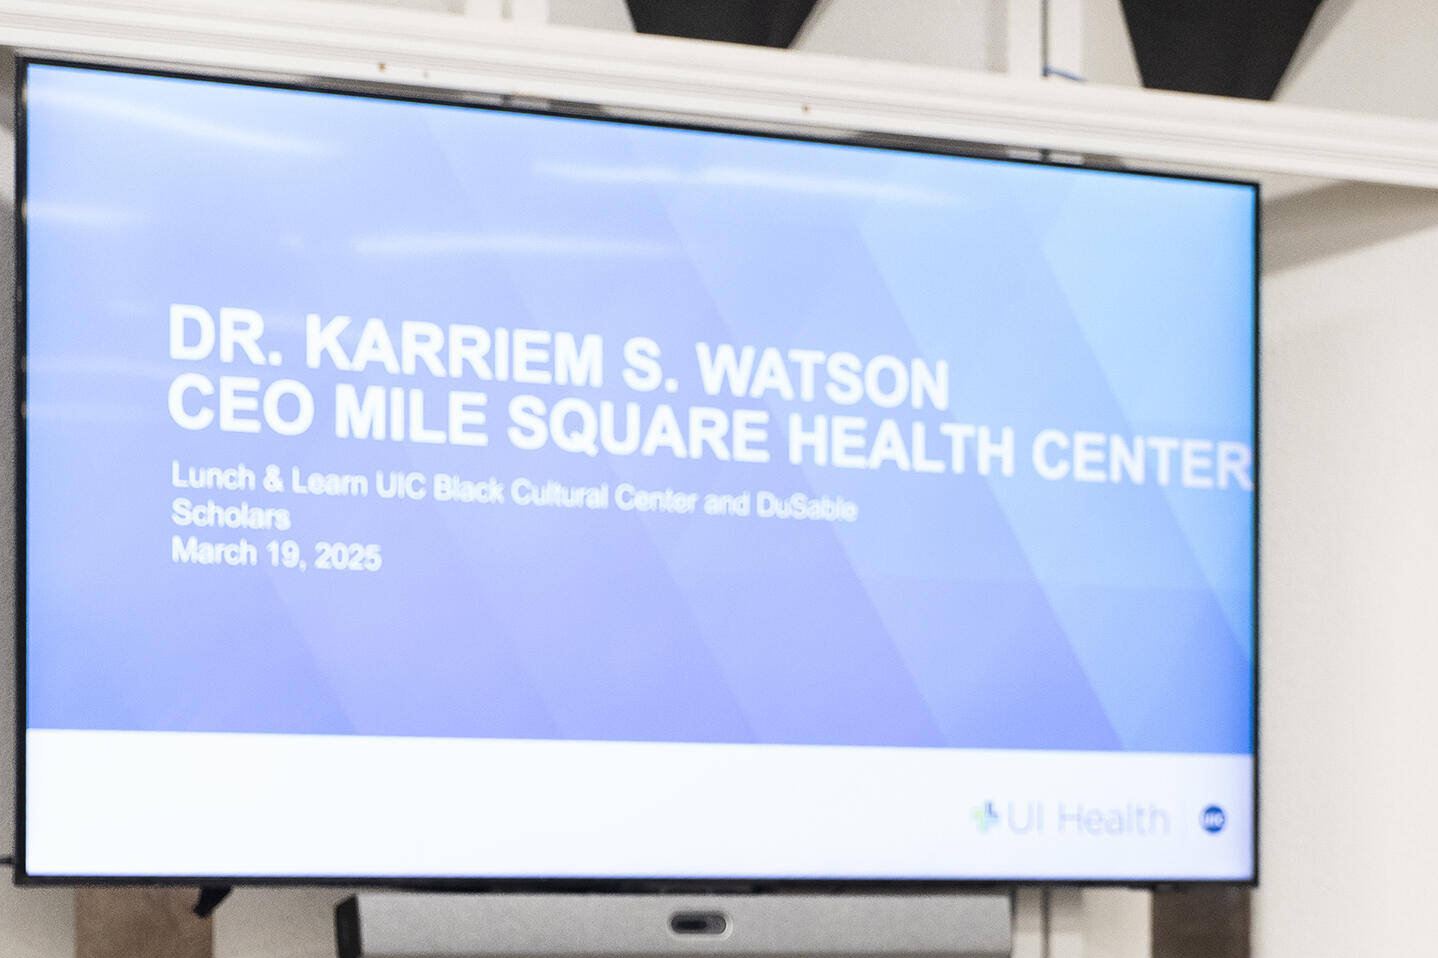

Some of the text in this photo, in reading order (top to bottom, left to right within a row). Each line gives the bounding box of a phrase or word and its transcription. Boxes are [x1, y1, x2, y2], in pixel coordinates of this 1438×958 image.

[169, 303, 949, 410] DR. KARRIEM S. WATSON
[168, 373, 1255, 492] CEO MILE SQUARE HEALTH CENTER
[171, 497, 291, 532] Scholars
[172, 460, 858, 524] Lunch & Learn UIC Black Cultural Center and DuSable
[171, 535, 383, 573] March 19, 2025
[1007, 800, 1171, 836] UI Health
